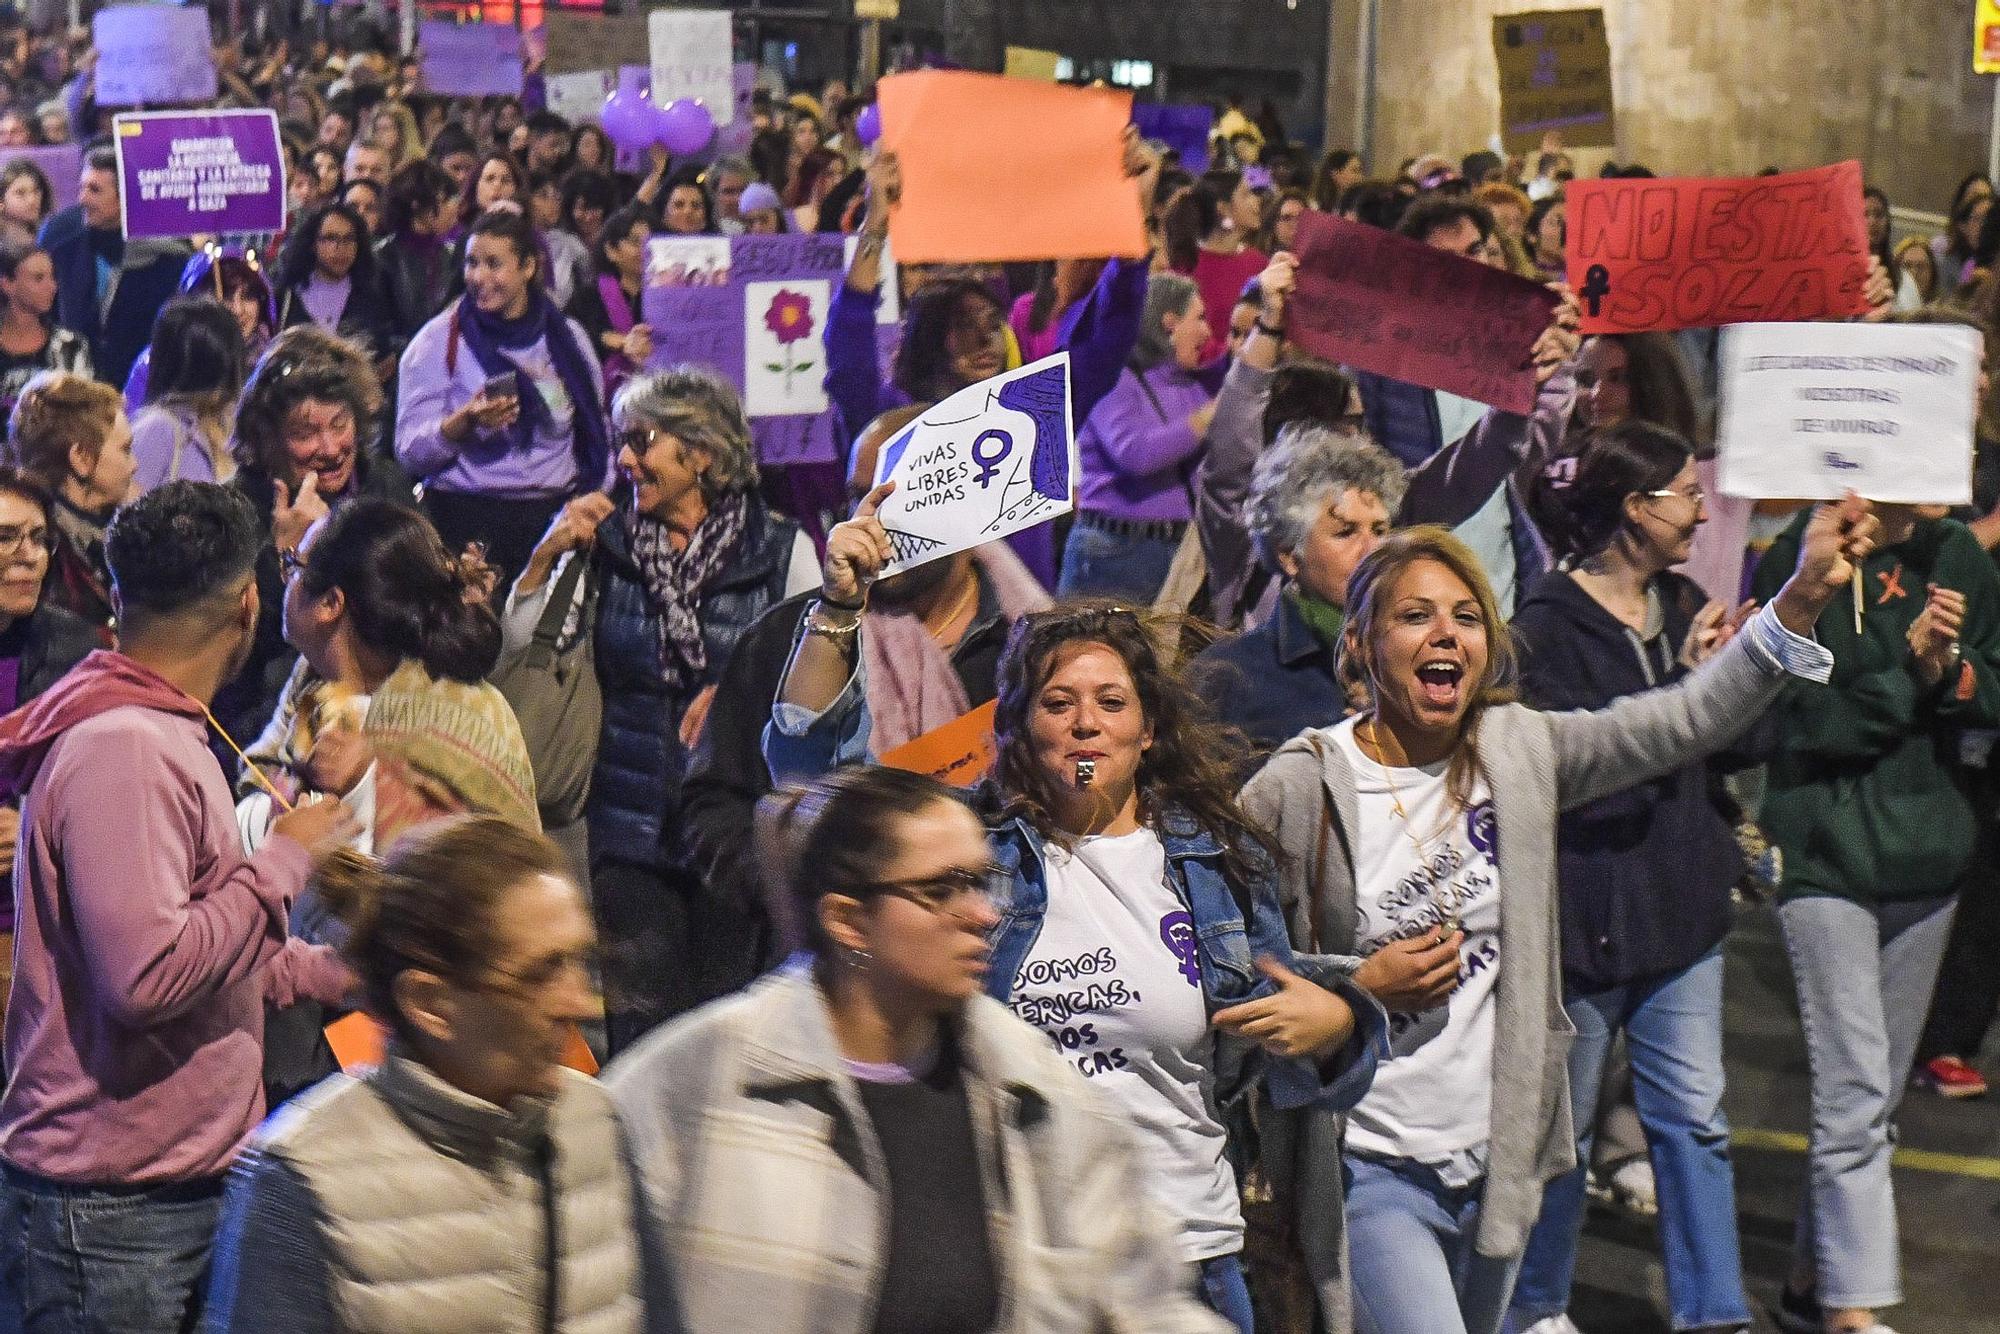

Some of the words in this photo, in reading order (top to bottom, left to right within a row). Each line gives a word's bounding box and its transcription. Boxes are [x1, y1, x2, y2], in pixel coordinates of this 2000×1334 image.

[1578, 187, 1677, 262] NO
[909, 442, 957, 471] VIVAS
[907, 462, 969, 492] LIBRES
[905, 485, 965, 512] UNIDAS
